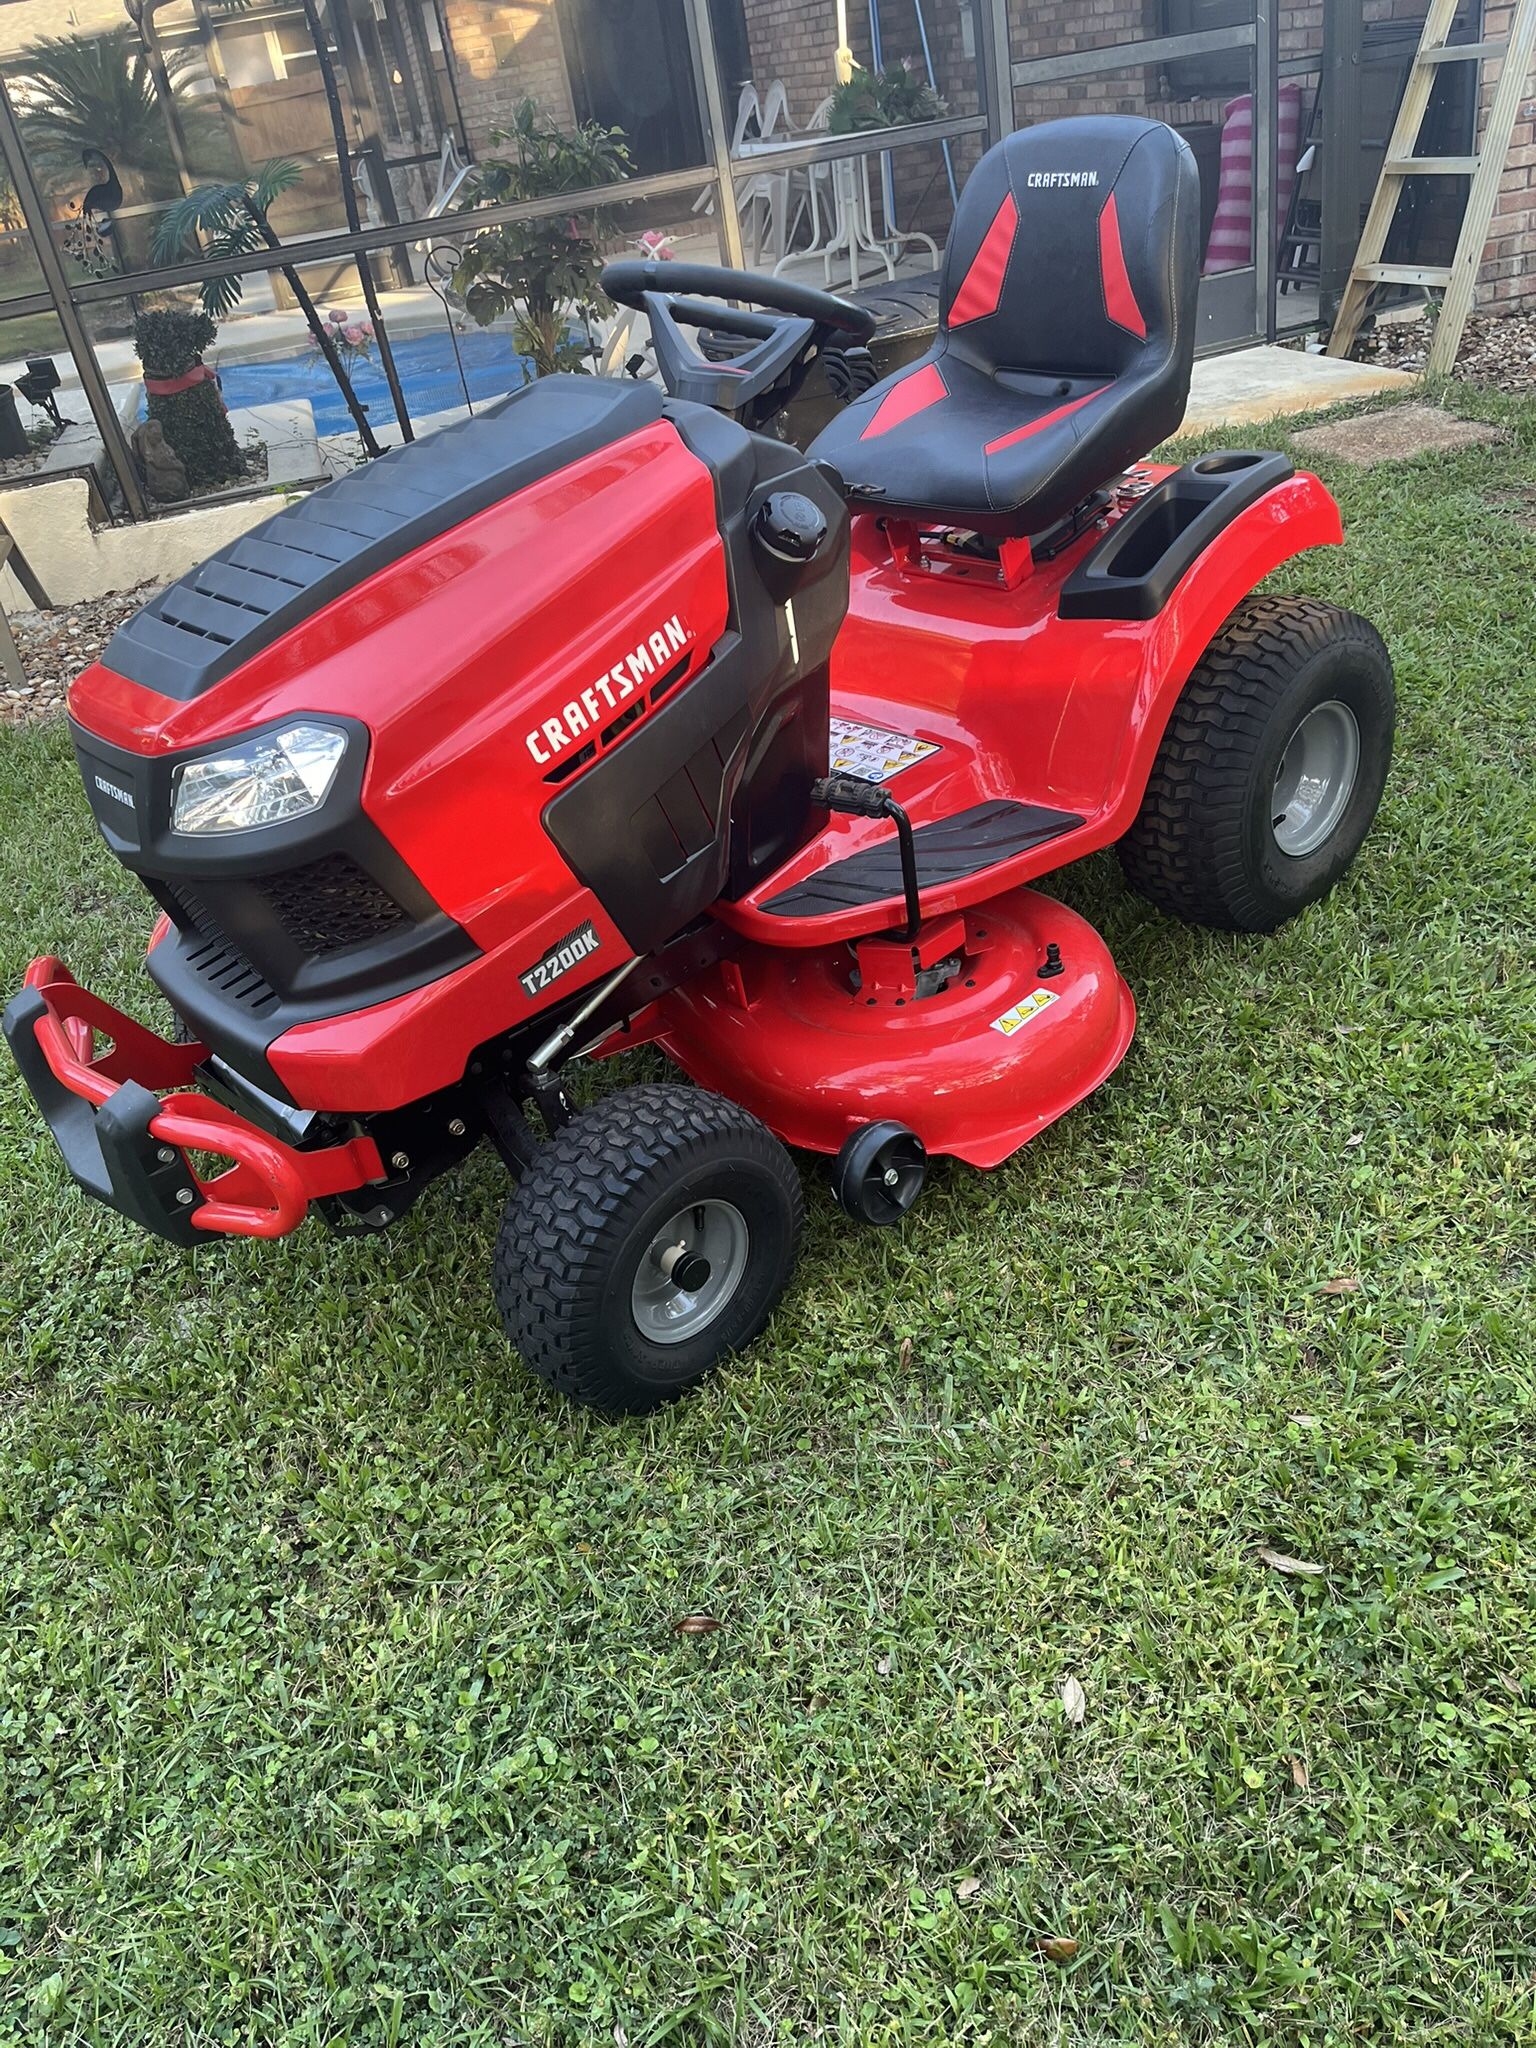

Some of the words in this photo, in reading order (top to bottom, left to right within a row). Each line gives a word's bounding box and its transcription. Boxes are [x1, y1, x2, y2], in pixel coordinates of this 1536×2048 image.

[1027, 171, 1097, 188] CRAFTSMAN
[526, 614, 687, 764] CRAFTSMAN
[521, 929, 600, 994] T2200K
